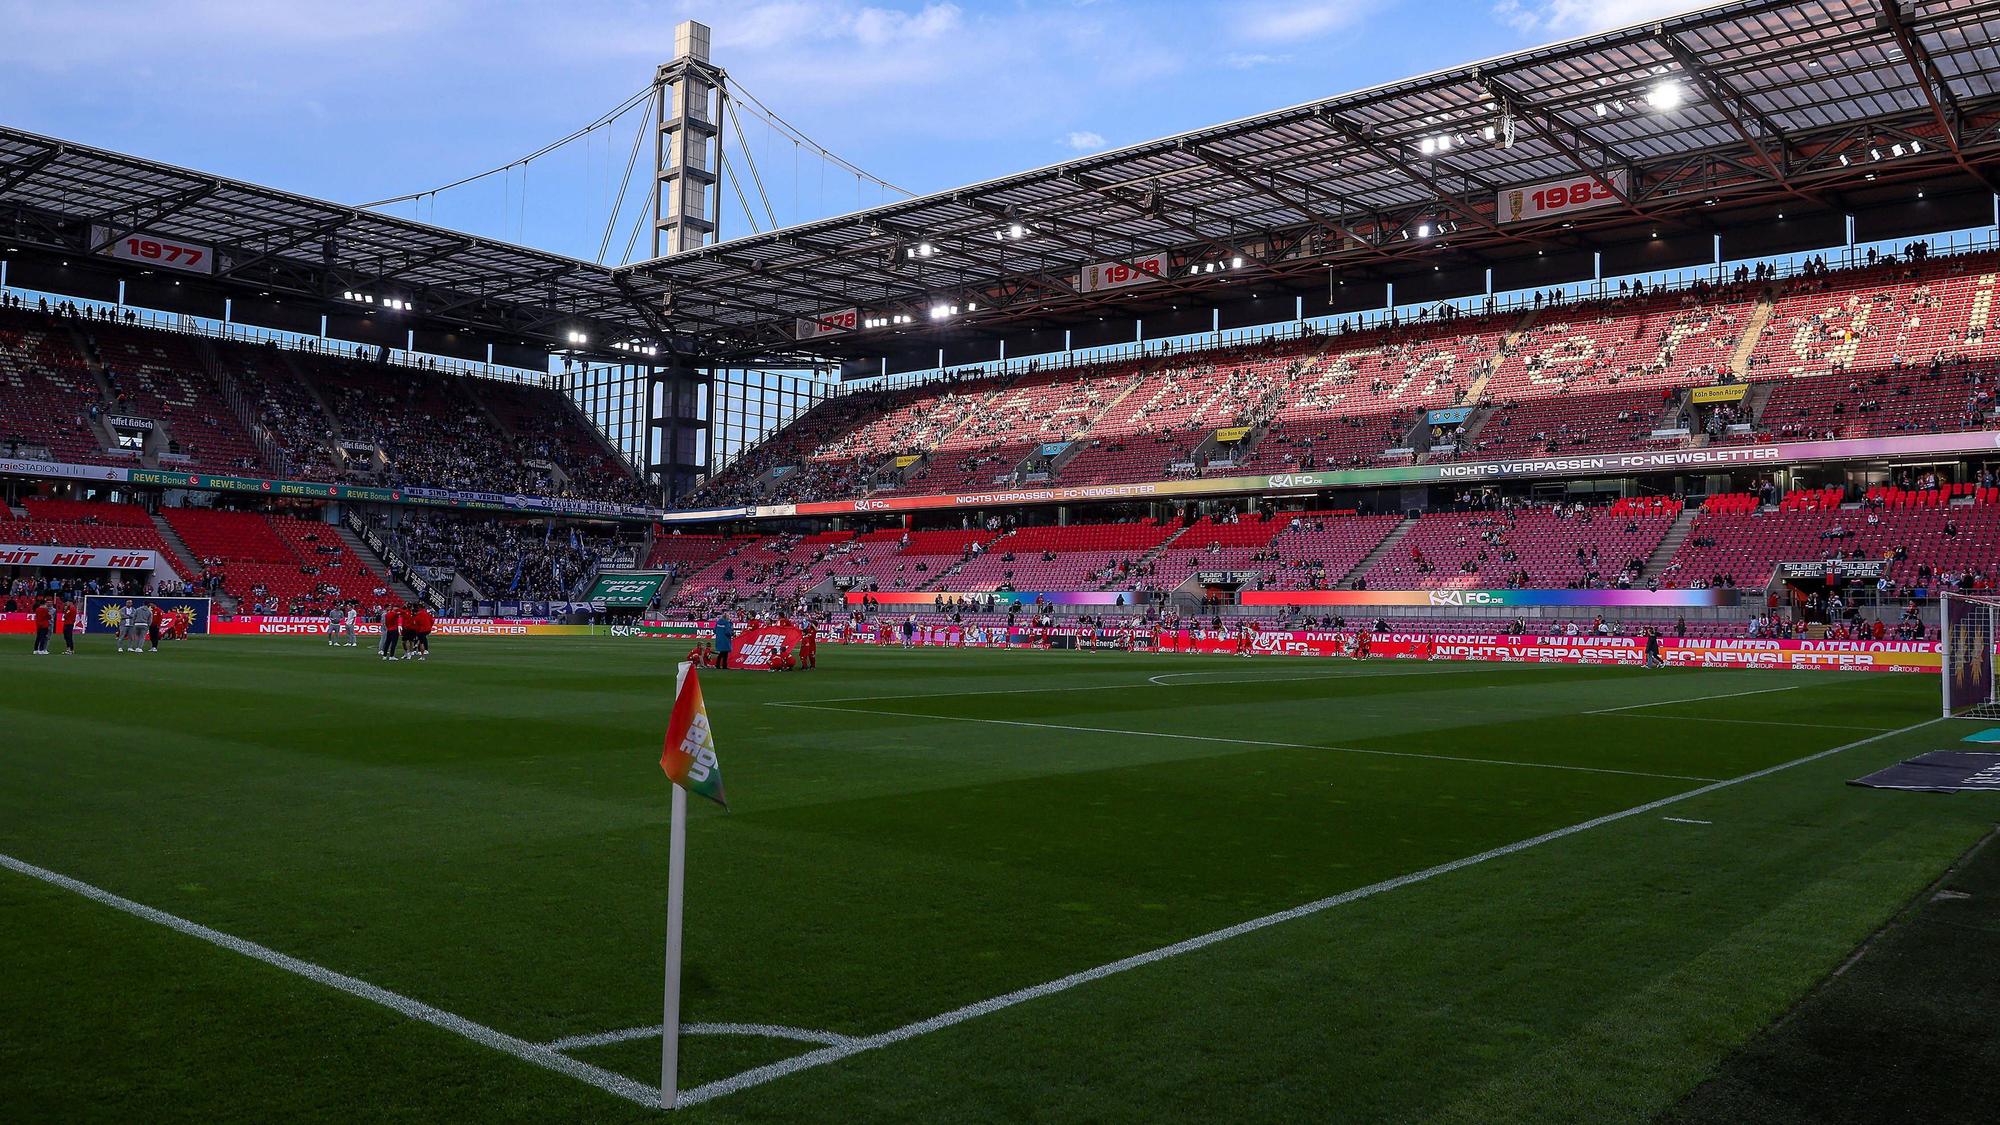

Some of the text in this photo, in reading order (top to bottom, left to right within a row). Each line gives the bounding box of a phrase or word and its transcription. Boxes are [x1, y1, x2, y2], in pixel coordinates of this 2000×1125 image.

[1532, 178, 1614, 210] 1983
[128, 239, 202, 266] 1977
[129, 418, 152, 429] Kölsch
[1440, 464, 1499, 476] NICHTS
[1501, 458, 1604, 474] VERPASSEN
[1621, 448, 1778, 467] FC-NEWSLETTER
[134, 474, 187, 485] REWE Bonus
[210, 479, 259, 491] REWE Bonus
[1294, 476, 1322, 485] FC.DE
[281, 485, 327, 496] REWE Bonus
[347, 490, 390, 500] REWE Bonus
[428, 489, 447, 497] SIND
[956, 495, 992, 504] NICHTS
[993, 491, 1054, 502] VERPASSEN
[1063, 485, 1155, 498] FC-NEWSLETTER
[541, 500, 581, 509] OSTKURVE
[52, 553, 95, 565] HIT
[108, 555, 149, 568] HIT
[1465, 591, 1504, 604] FC.DE
[259, 624, 318, 633] NICHTS
[430, 625, 527, 634] C-NEWSLETTER
[755, 634, 785, 646] LEBE
[740, 644, 766, 655] WIE
[1800, 642, 1868, 652] DATEN
[1870, 643, 1930, 653] OHNE
[1436, 646, 1873, 664] NICHTS VERPASSEN FC-NEWSLETTER
